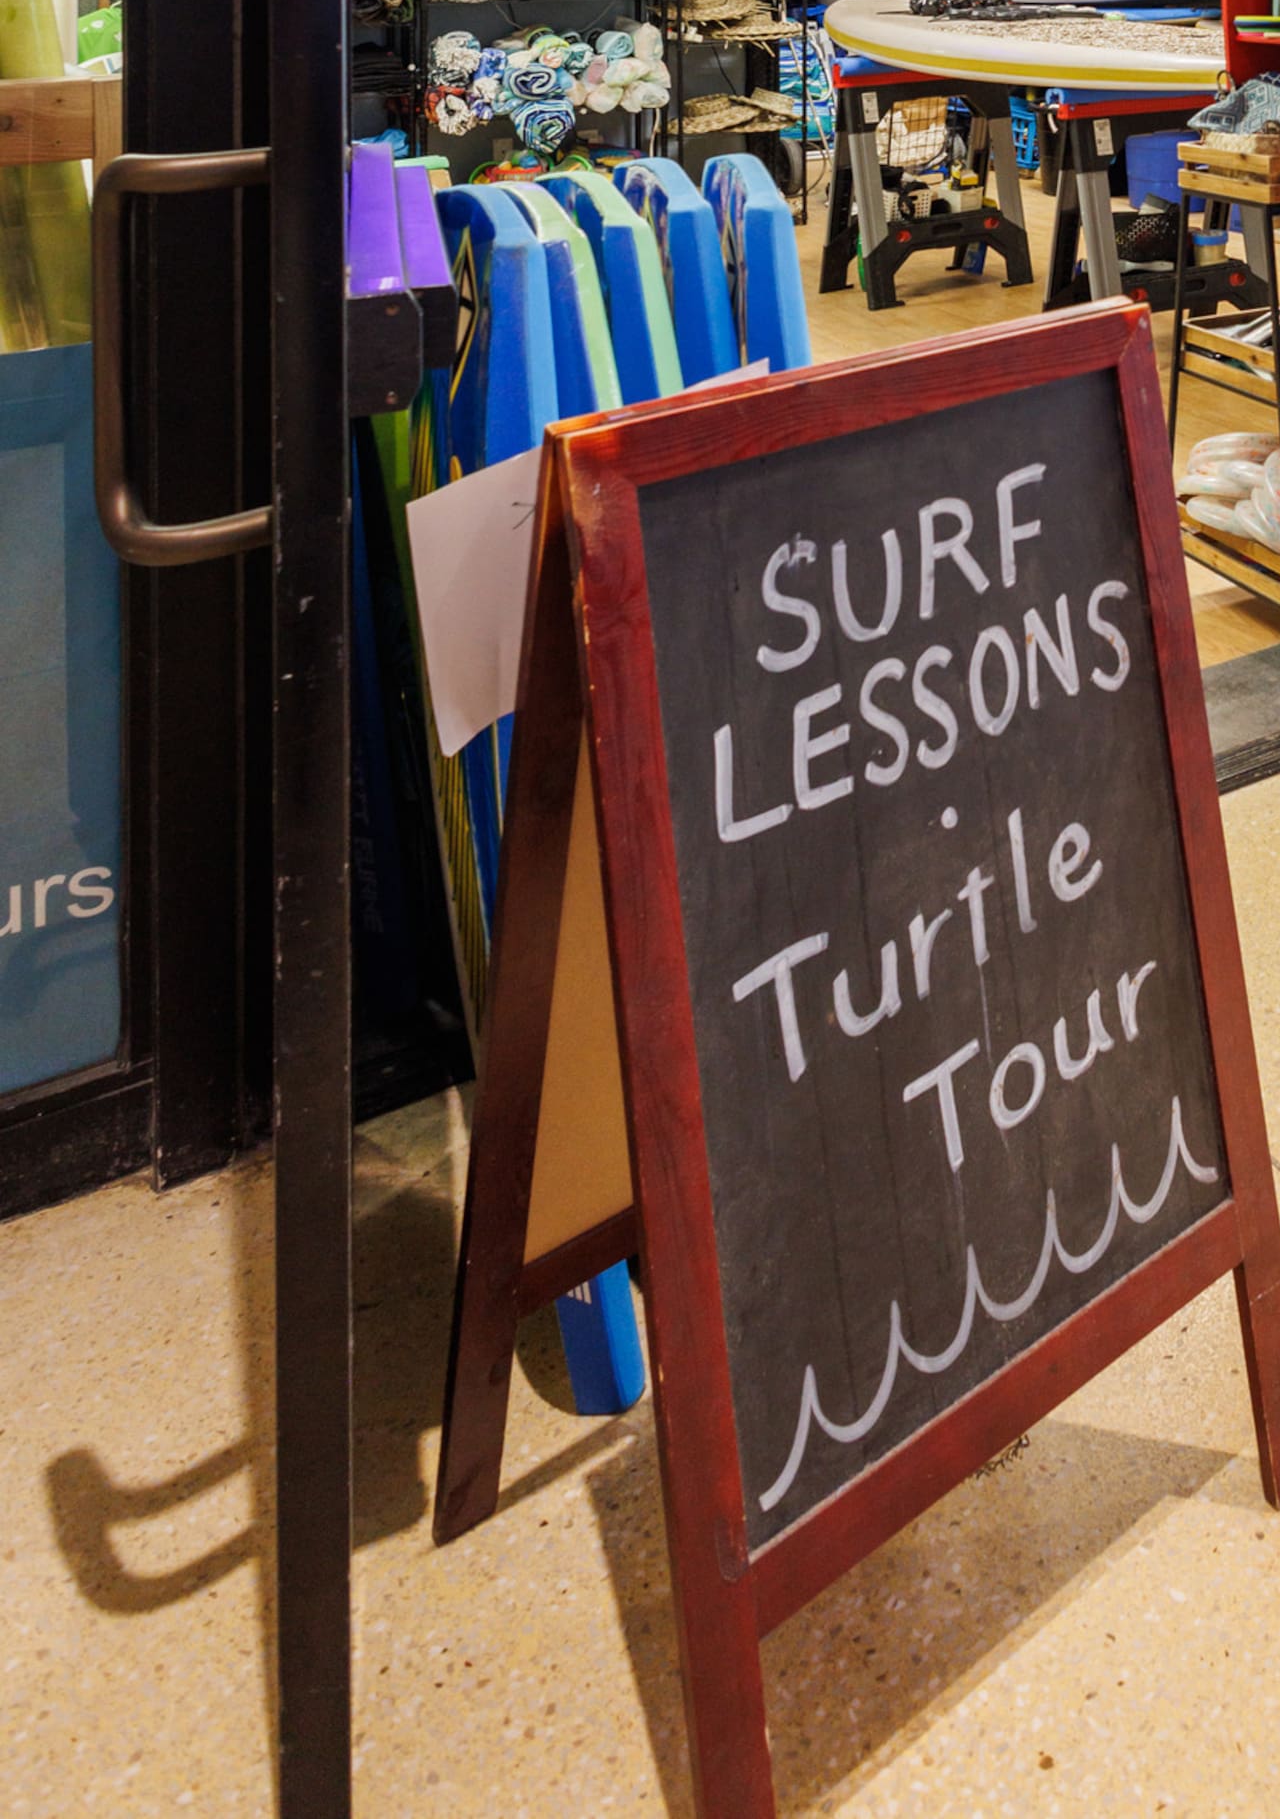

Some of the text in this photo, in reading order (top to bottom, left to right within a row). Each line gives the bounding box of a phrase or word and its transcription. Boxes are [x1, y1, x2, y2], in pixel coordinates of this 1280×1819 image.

[756, 463, 1047, 673] SURF
[713, 580, 1129, 844] LESSONS
[732, 807, 1103, 1082] Turtle
[902, 960, 1157, 1174] Tour
